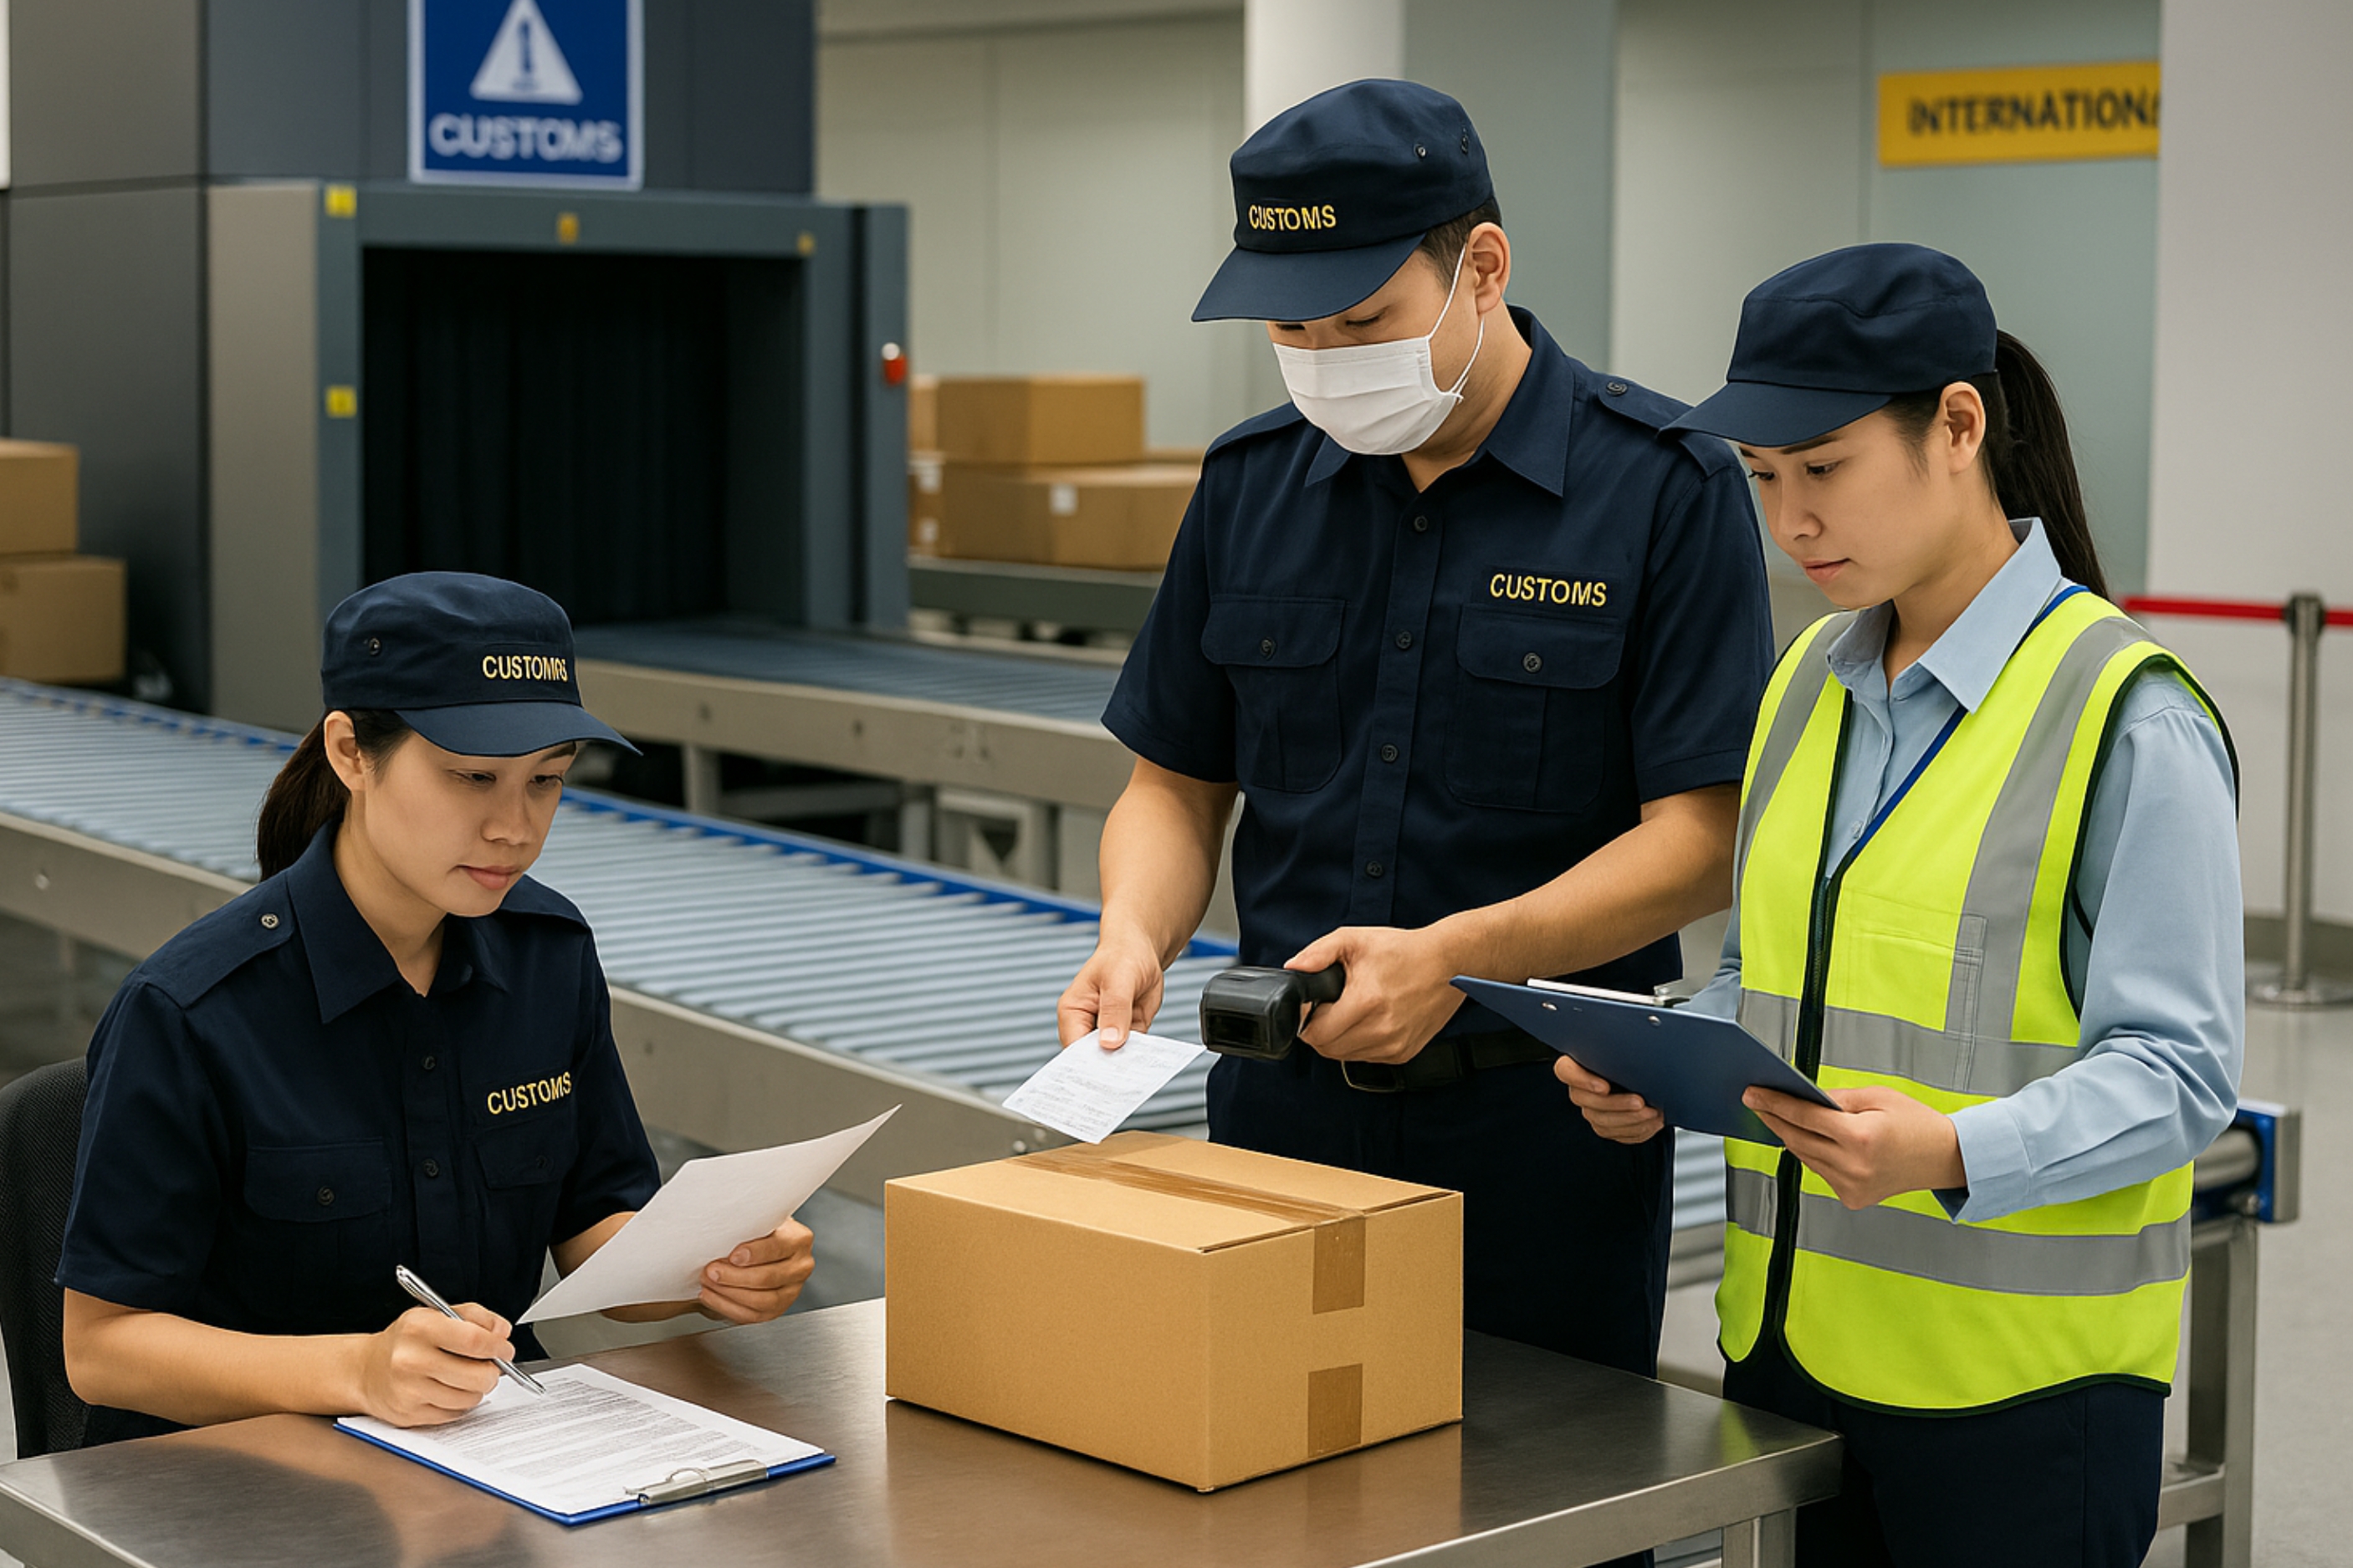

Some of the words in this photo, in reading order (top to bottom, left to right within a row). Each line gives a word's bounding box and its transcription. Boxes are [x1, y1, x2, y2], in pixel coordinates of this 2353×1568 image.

[428, 112, 624, 164] CUSTOMS
[1248, 204, 1337, 231] CUSTOMS
[1490, 573, 1607, 607] CUSTOMS
[487, 1071, 572, 1115] CUSTOMS
